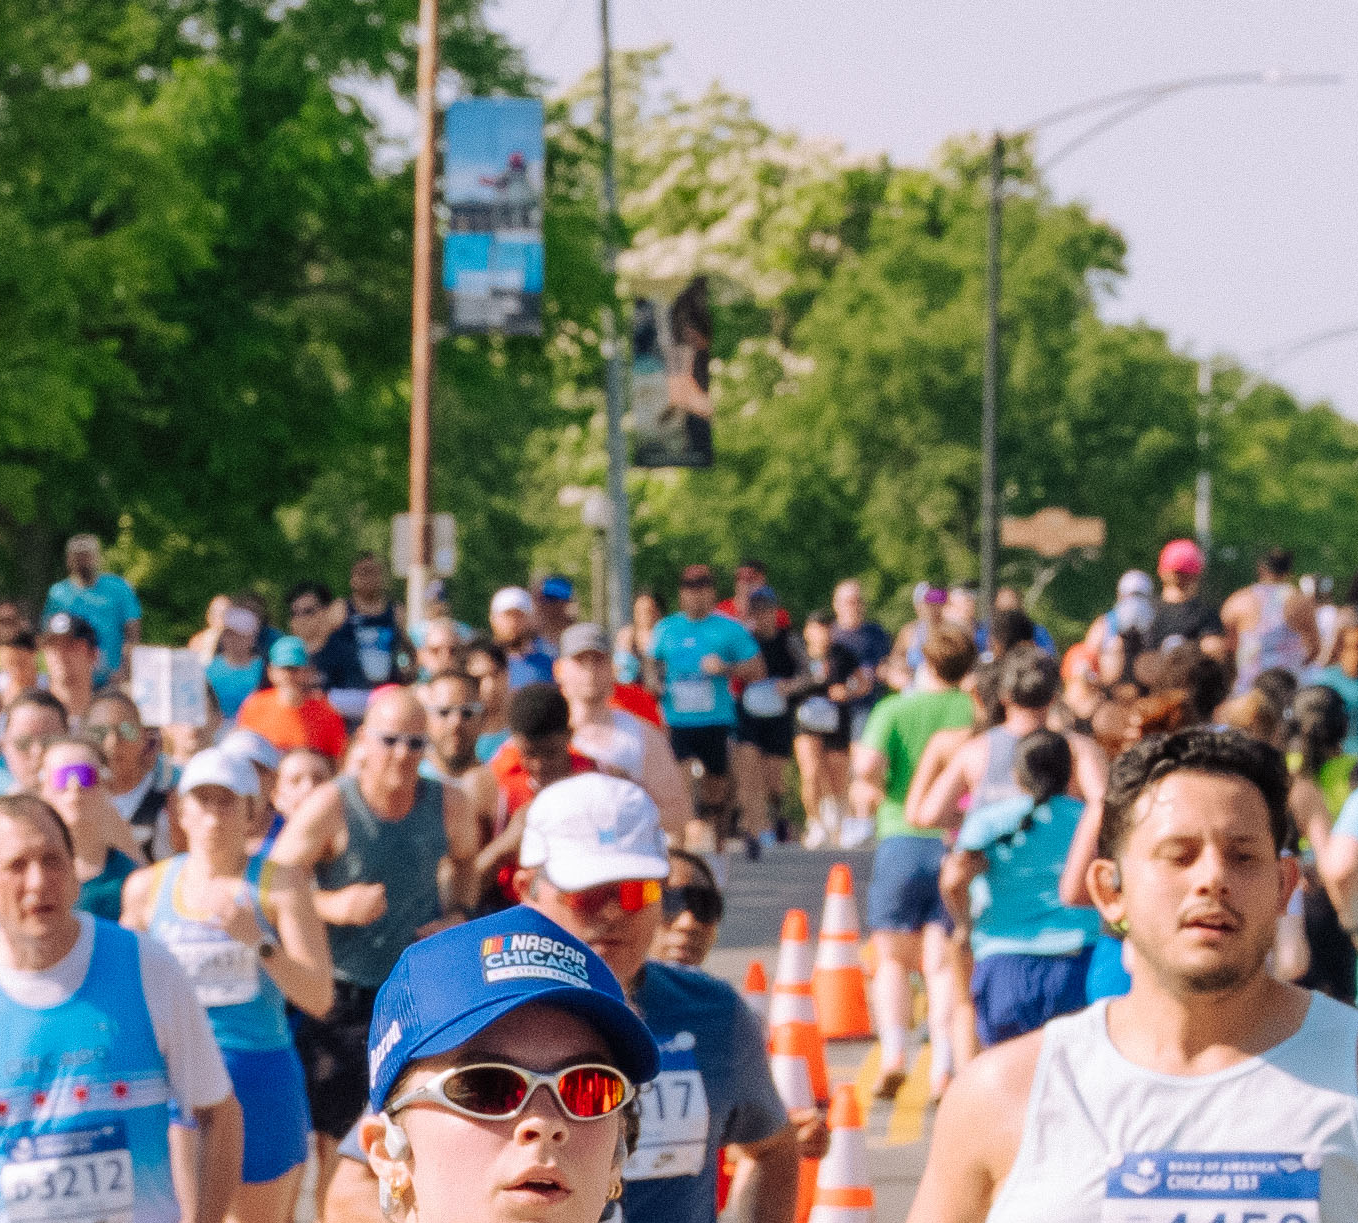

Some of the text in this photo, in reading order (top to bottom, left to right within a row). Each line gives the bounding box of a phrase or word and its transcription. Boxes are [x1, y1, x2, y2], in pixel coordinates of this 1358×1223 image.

[485, 950, 589, 981] CHICAGO
[510, 934, 587, 968] NASCAR
[41, 1158, 123, 1199] 3212
